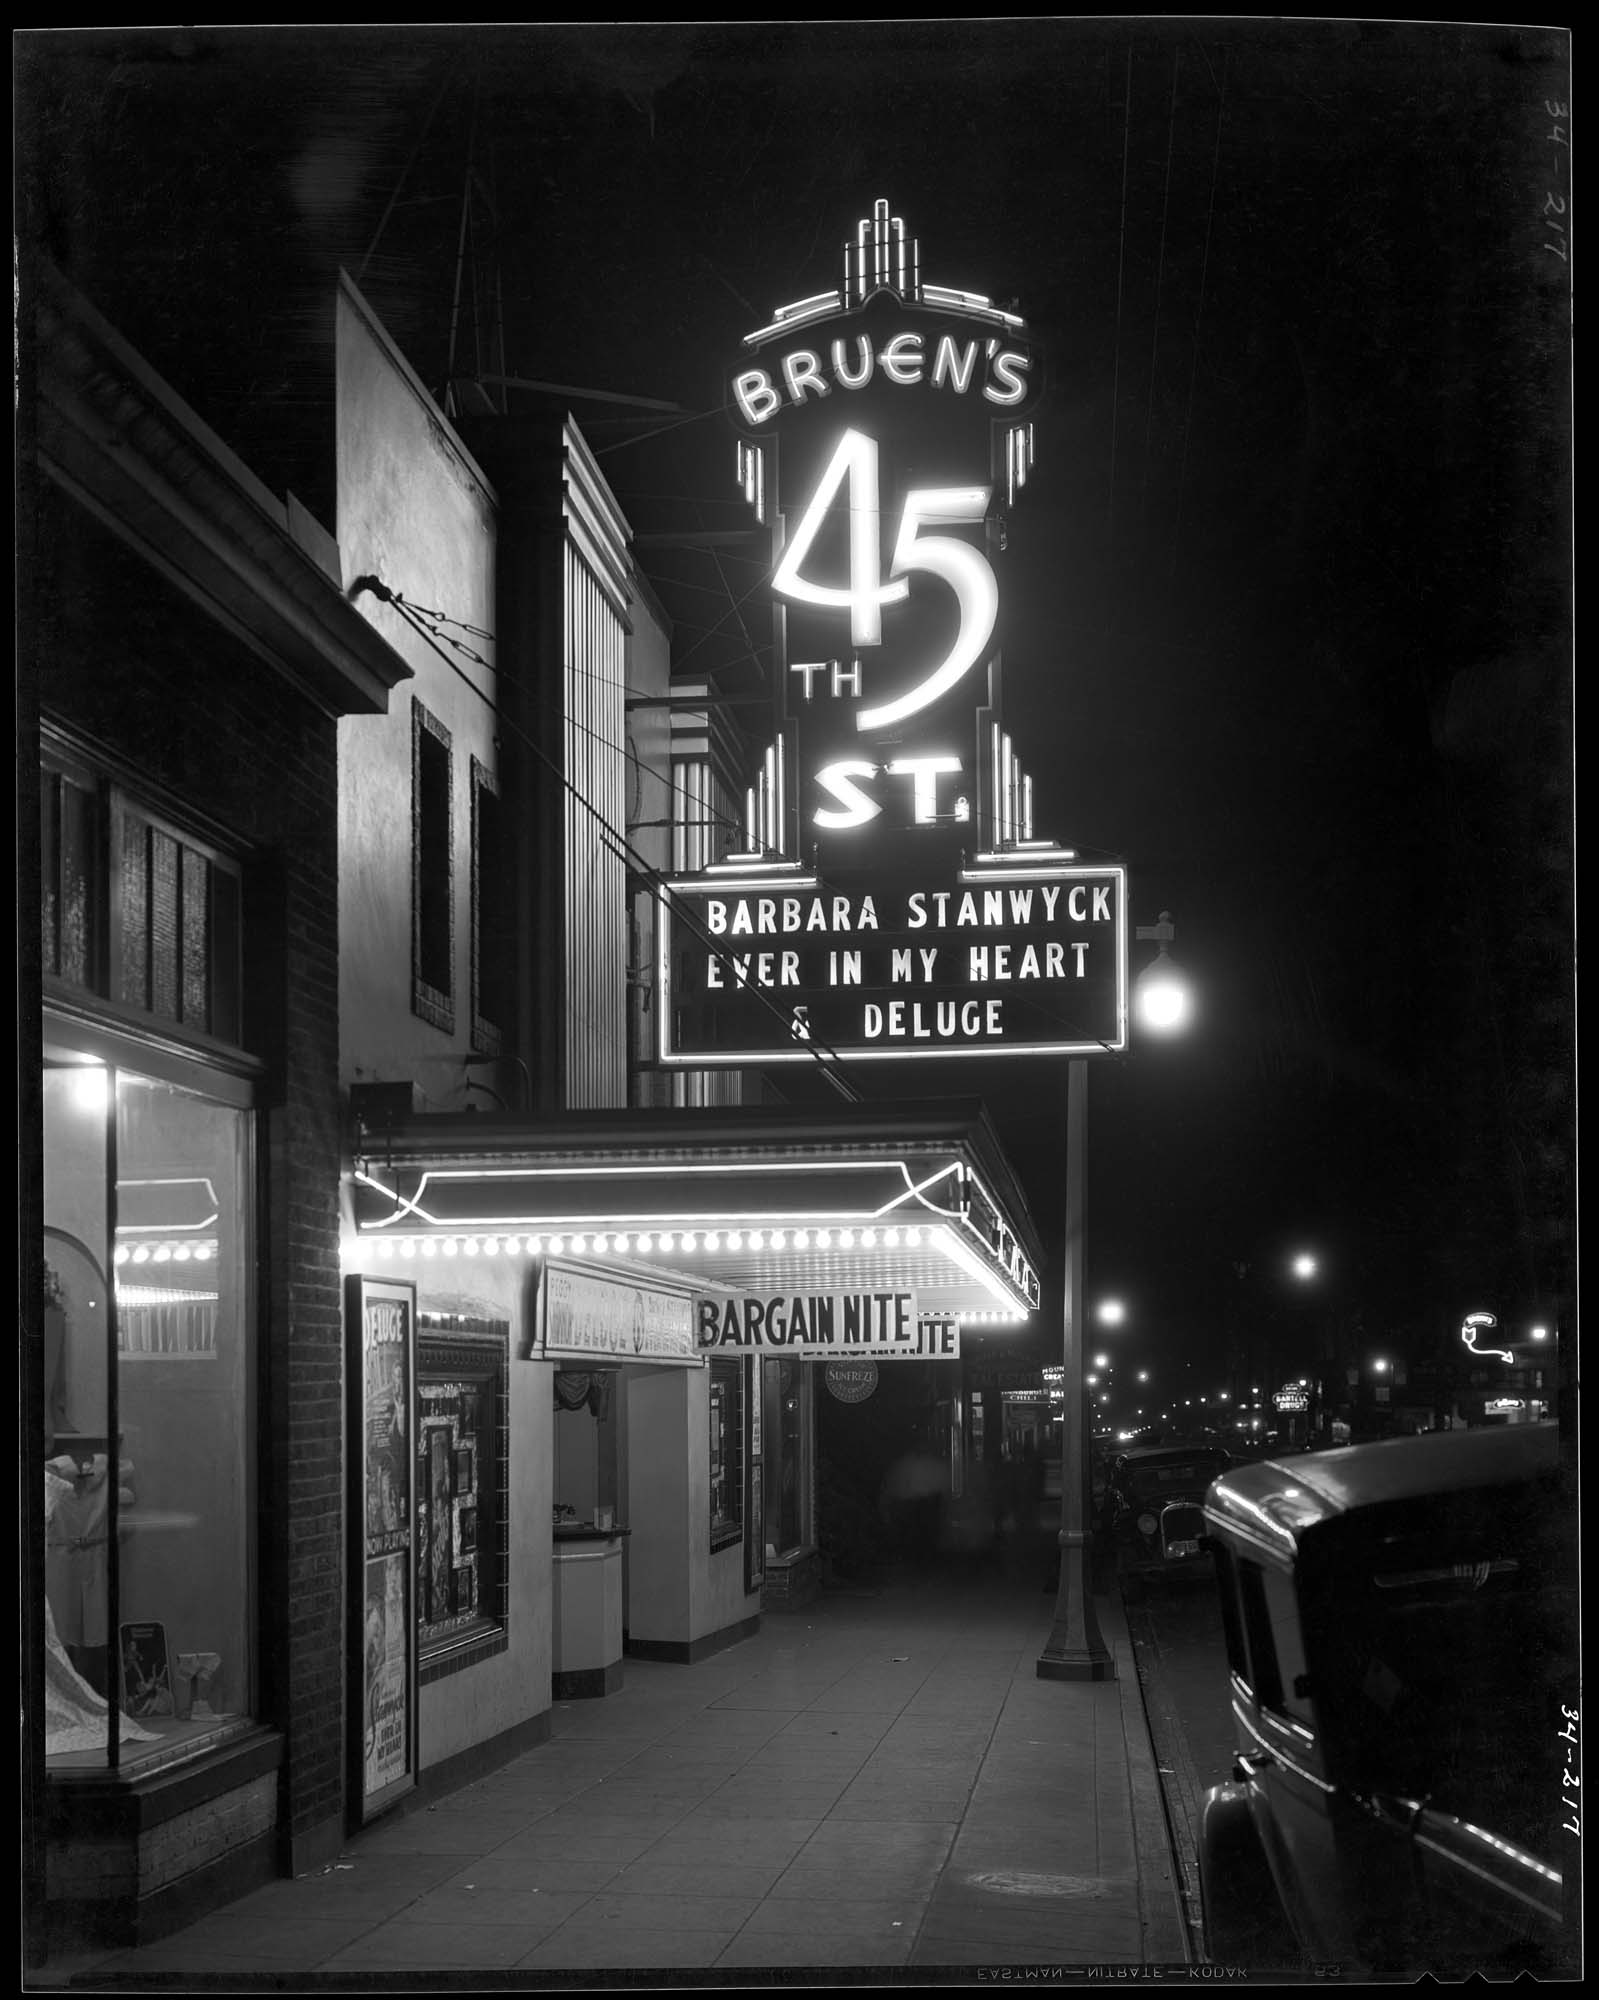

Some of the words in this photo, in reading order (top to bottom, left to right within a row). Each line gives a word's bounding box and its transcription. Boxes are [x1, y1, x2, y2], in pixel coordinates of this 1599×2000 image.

[732, 334, 1028, 424] BRUEN'S
[772, 427, 999, 731] 45
[790, 660, 863, 700] TH
[813, 755, 970, 829] ST.
[706, 895, 880, 935] BARBARA
[907, 885, 1112, 929] STANWYCK
[706, 951, 801, 989] EVER
[830, 950, 863, 985] IN
[892, 947, 938, 983] MY
[968, 941, 1090, 981] HEART
[791, 1006, 811, 1040] &
[864, 1000, 1004, 1039] DELUGE
[697, 1296, 833, 1348] BARGAIN
[843, 1293, 912, 1344] NITE
[1558, 1704, 1581, 1836] 34-217
